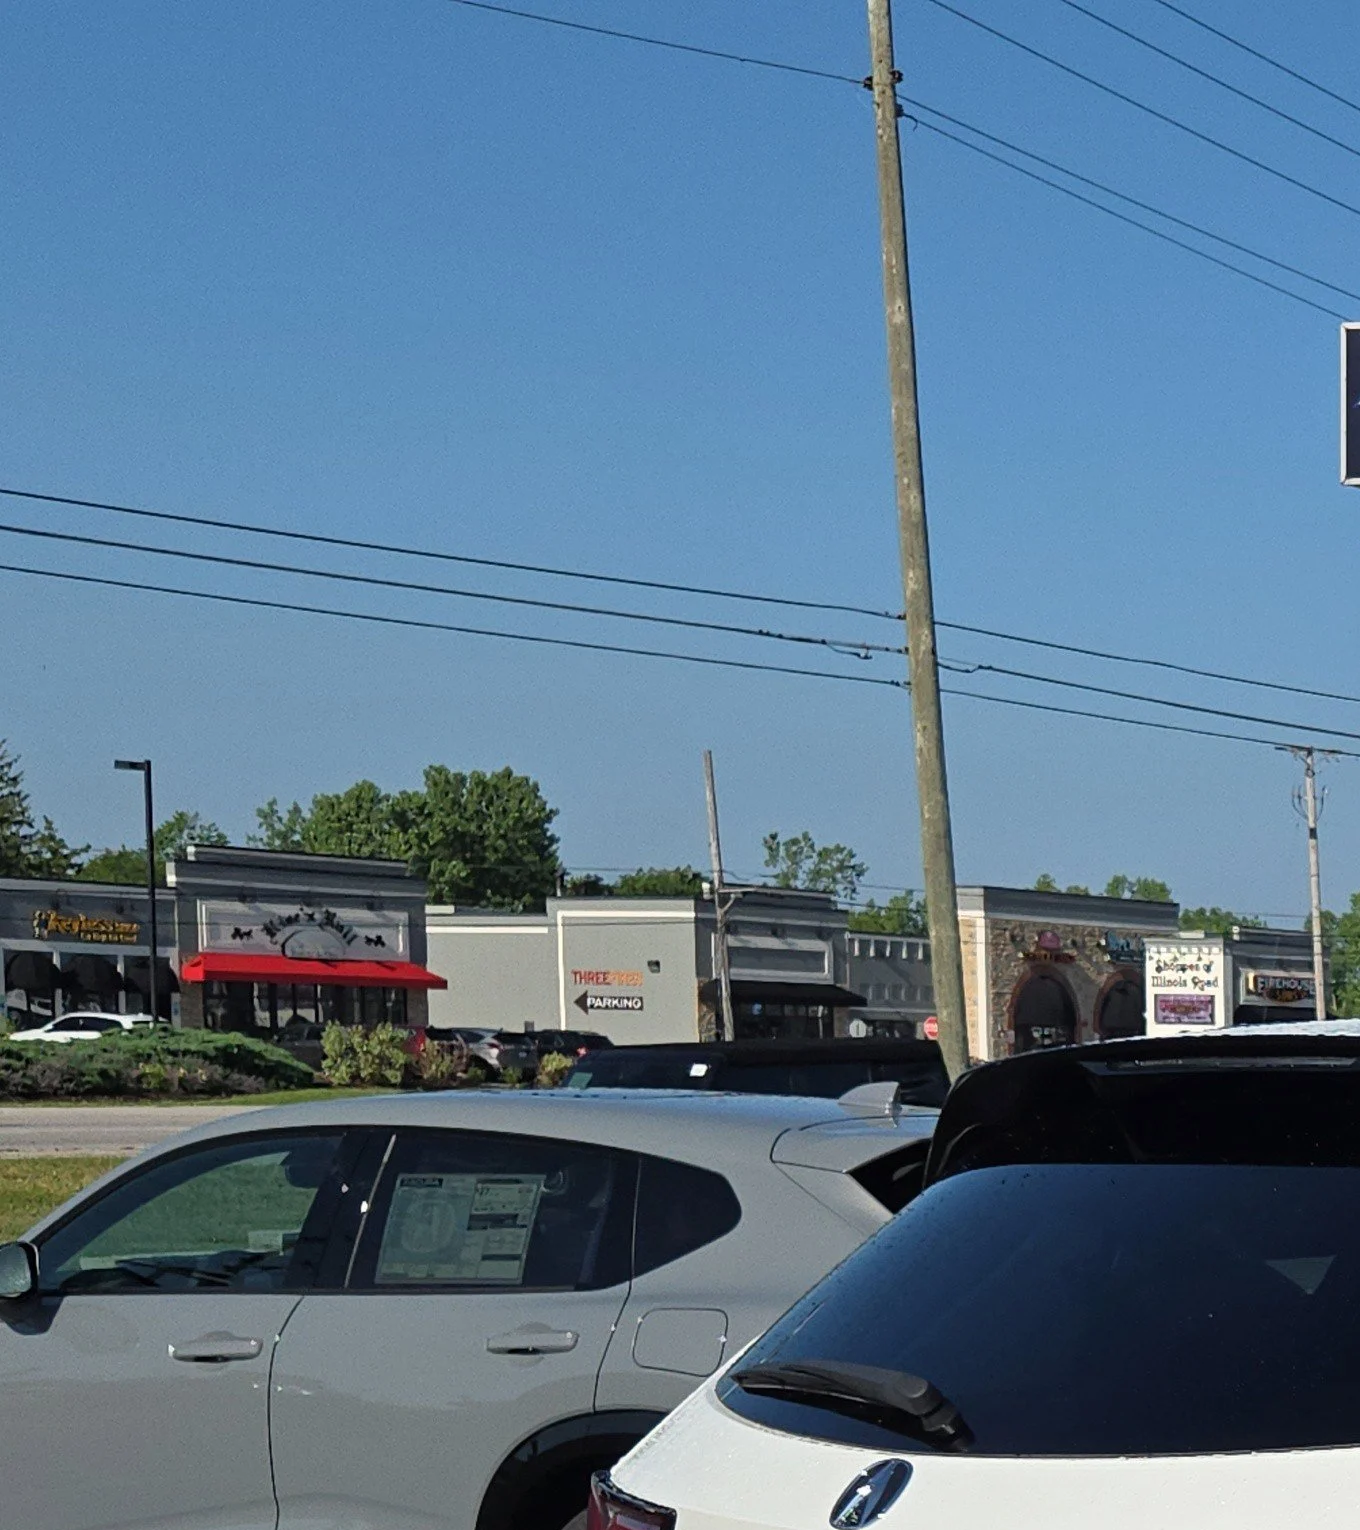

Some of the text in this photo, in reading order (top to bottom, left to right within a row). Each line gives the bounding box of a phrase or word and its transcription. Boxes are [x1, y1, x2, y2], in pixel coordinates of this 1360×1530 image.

[571, 969, 612, 986] THREE
[1151, 975, 1188, 988] Illinois
[587, 997, 642, 1009] PARKING
